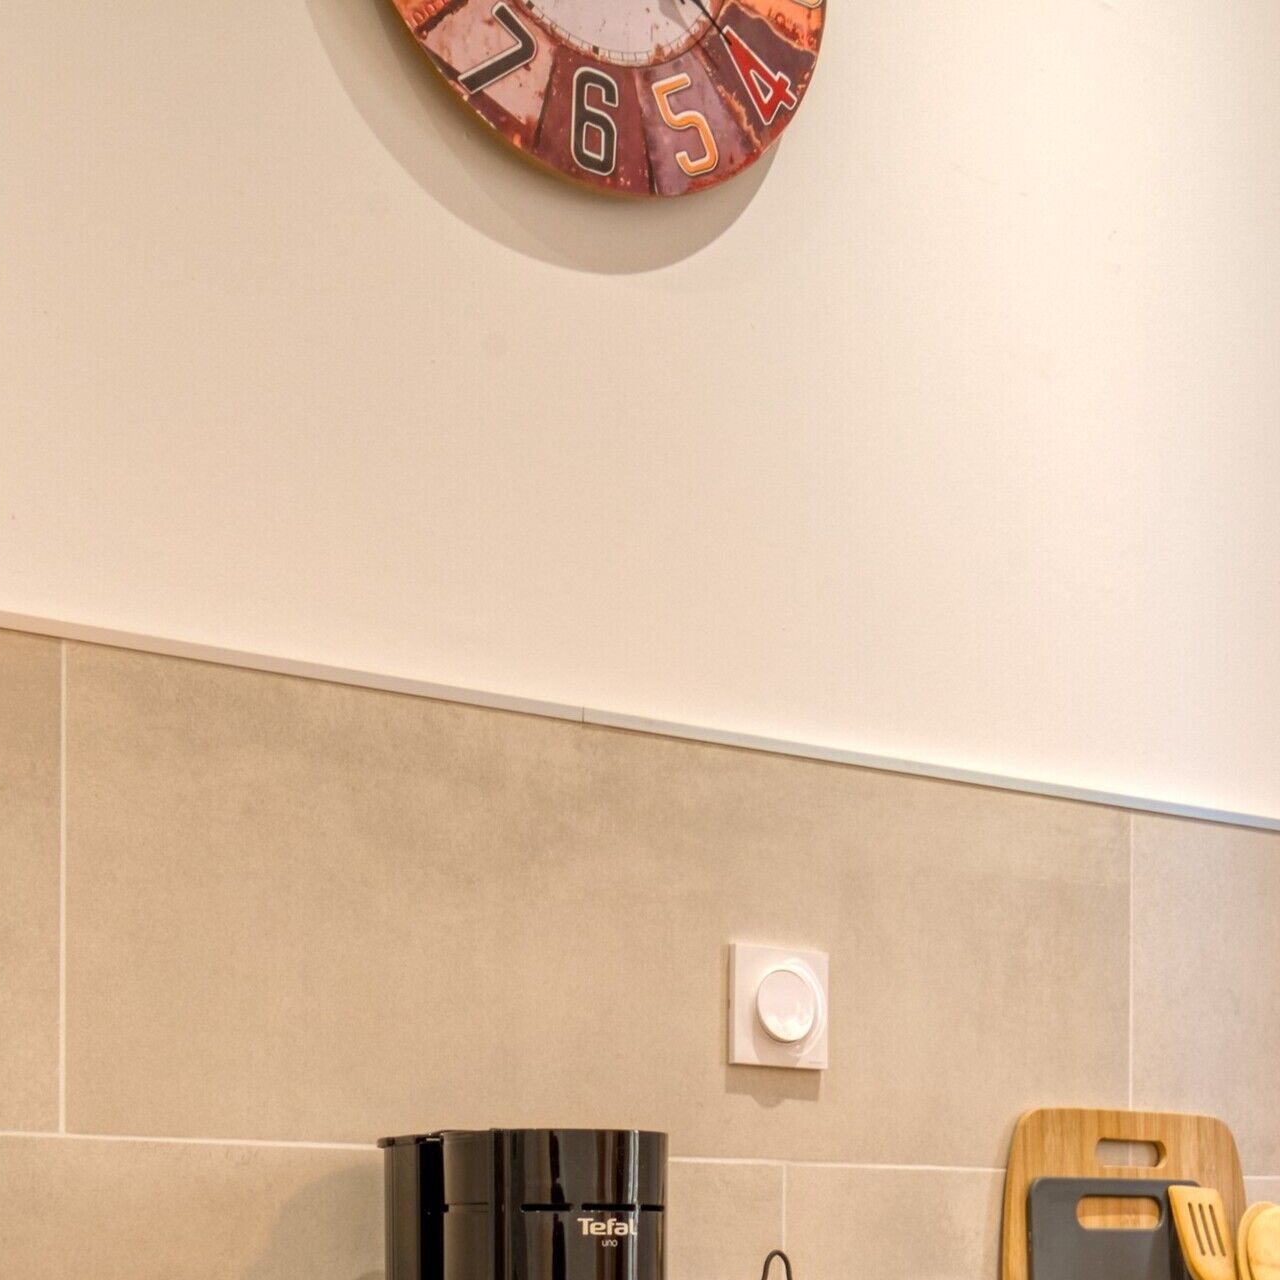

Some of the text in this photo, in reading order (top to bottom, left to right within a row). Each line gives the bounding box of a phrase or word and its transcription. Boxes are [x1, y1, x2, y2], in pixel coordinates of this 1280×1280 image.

[457, 1, 538, 94] 7
[720, 25, 797, 125] 4
[571, 66, 619, 176] 6
[652, 73, 718, 176] 5
[577, 1217, 638, 1236] Tefal
